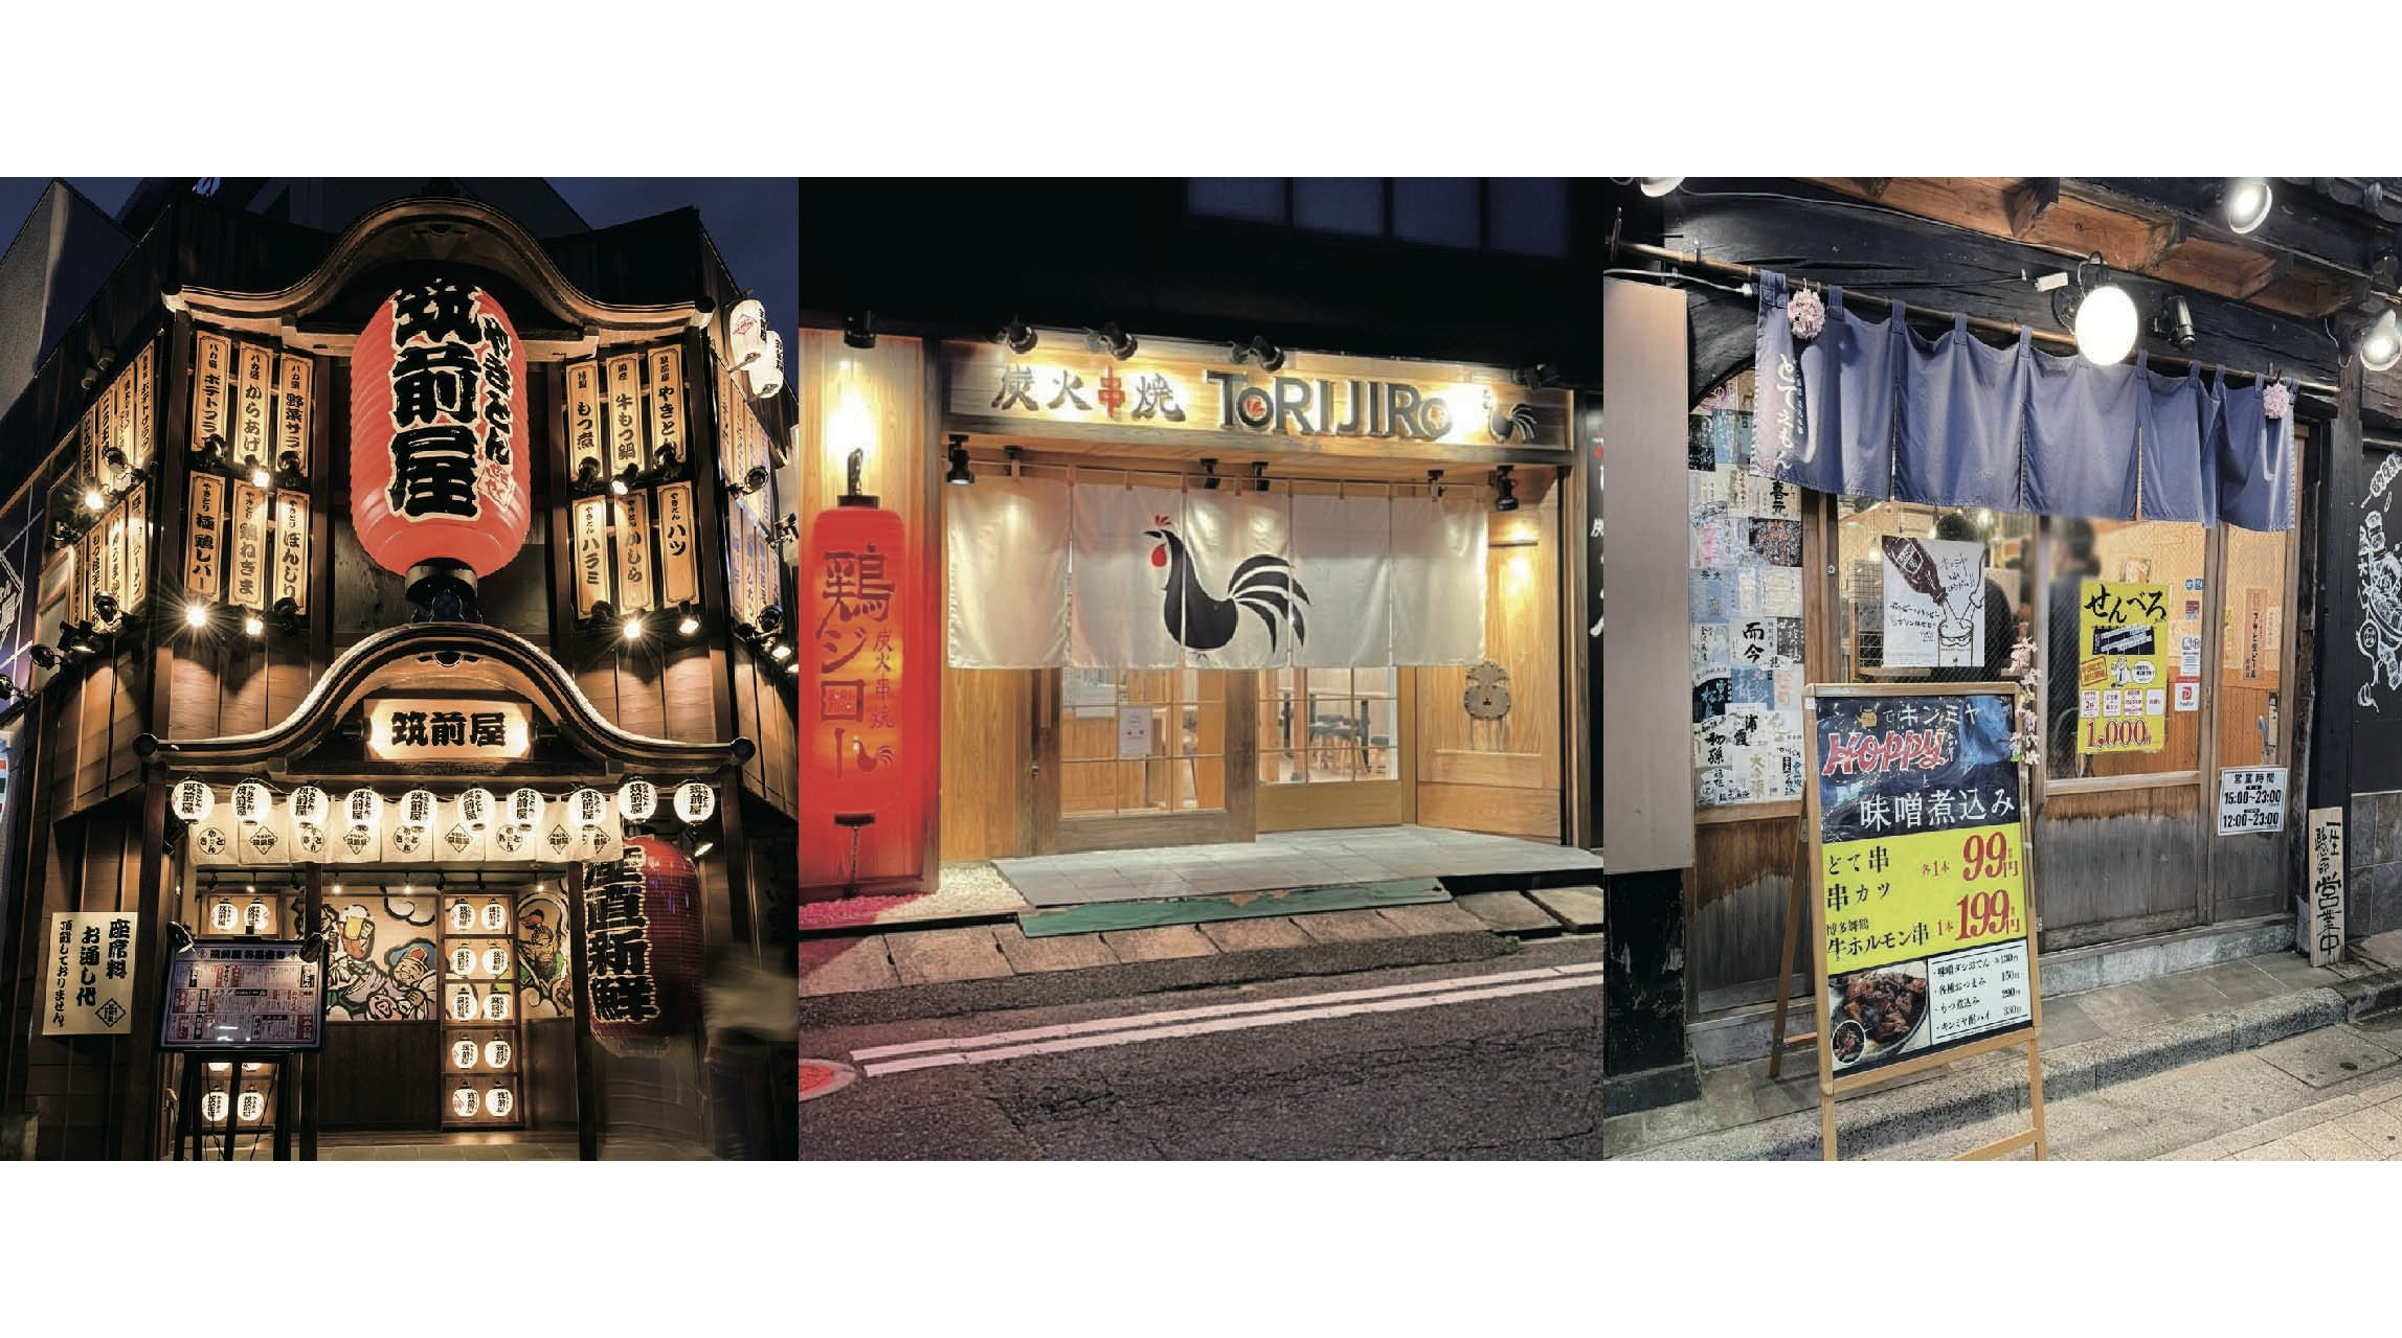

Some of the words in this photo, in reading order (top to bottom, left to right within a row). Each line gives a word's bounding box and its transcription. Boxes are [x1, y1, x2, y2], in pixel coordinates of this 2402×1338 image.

[202, 373, 220, 440] ポテトフラ
[243, 383, 262, 452] からあげ
[285, 392, 304, 453] 野菜サラ
[393, 279, 484, 517] 筑前屋
[658, 385, 676, 450] やきと
[991, 363, 1187, 422] 炭火串焼
[615, 393, 636, 460] 牛もつ鍋
[582, 537, 600, 585] ハラミ
[667, 523, 687, 557] ハツ
[2084, 583, 2168, 624] せんべろ
[815, 543, 895, 779] 鶏ジロー
[1742, 622, 1765, 663] 而今
[870, 629, 895, 729] 炭火串焼
[391, 711, 506, 747] 筑前屋
[1921, 773, 1931, 789] と
[2234, 773, 2275, 784] 営業時間
[1860, 787, 2016, 832] 味噌煮込み
[1828, 845, 1890, 876] どて串
[1921, 859, 1950, 877] 各1本
[1962, 831, 2019, 882] 99円
[1826, 922, 1929, 956] 牛ホルモン串
[1936, 919, 1954, 937] 1本
[1955, 889, 2020, 942] 199円
[1827, 882, 1891, 912] 串カツ
[2315, 871, 2342, 956] 営業中
[76, 926, 100, 1006] お通し代
